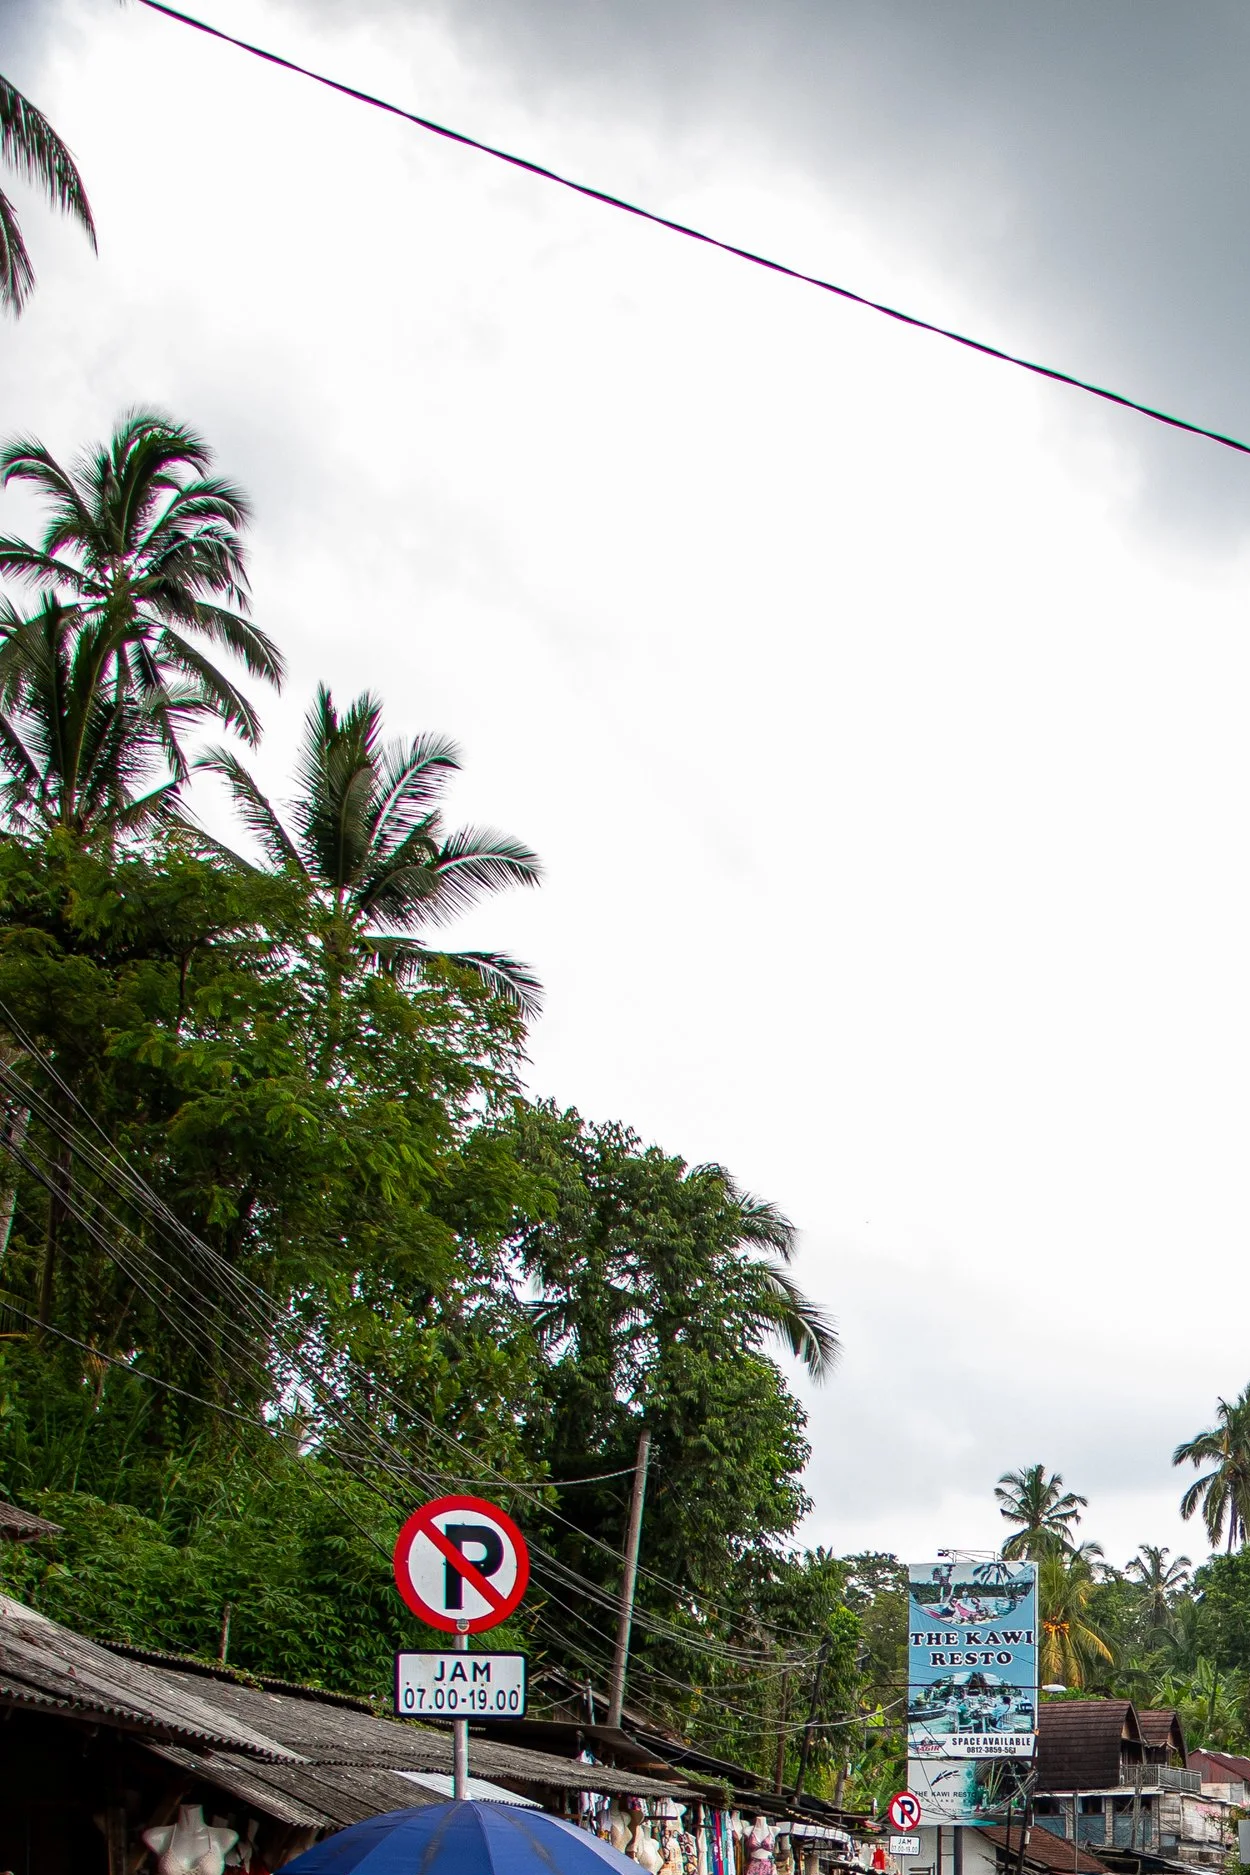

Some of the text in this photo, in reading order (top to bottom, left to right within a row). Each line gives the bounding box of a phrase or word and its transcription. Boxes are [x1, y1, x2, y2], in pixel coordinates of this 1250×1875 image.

[911, 1630, 1034, 1646] THE KAWI
[931, 1651, 1013, 1666] RESTO
[434, 1661, 491, 1682] JAM
[404, 1688, 520, 1710] 07.00-19.00
[952, 1737, 1031, 1746] SPACE AVAILABLE
